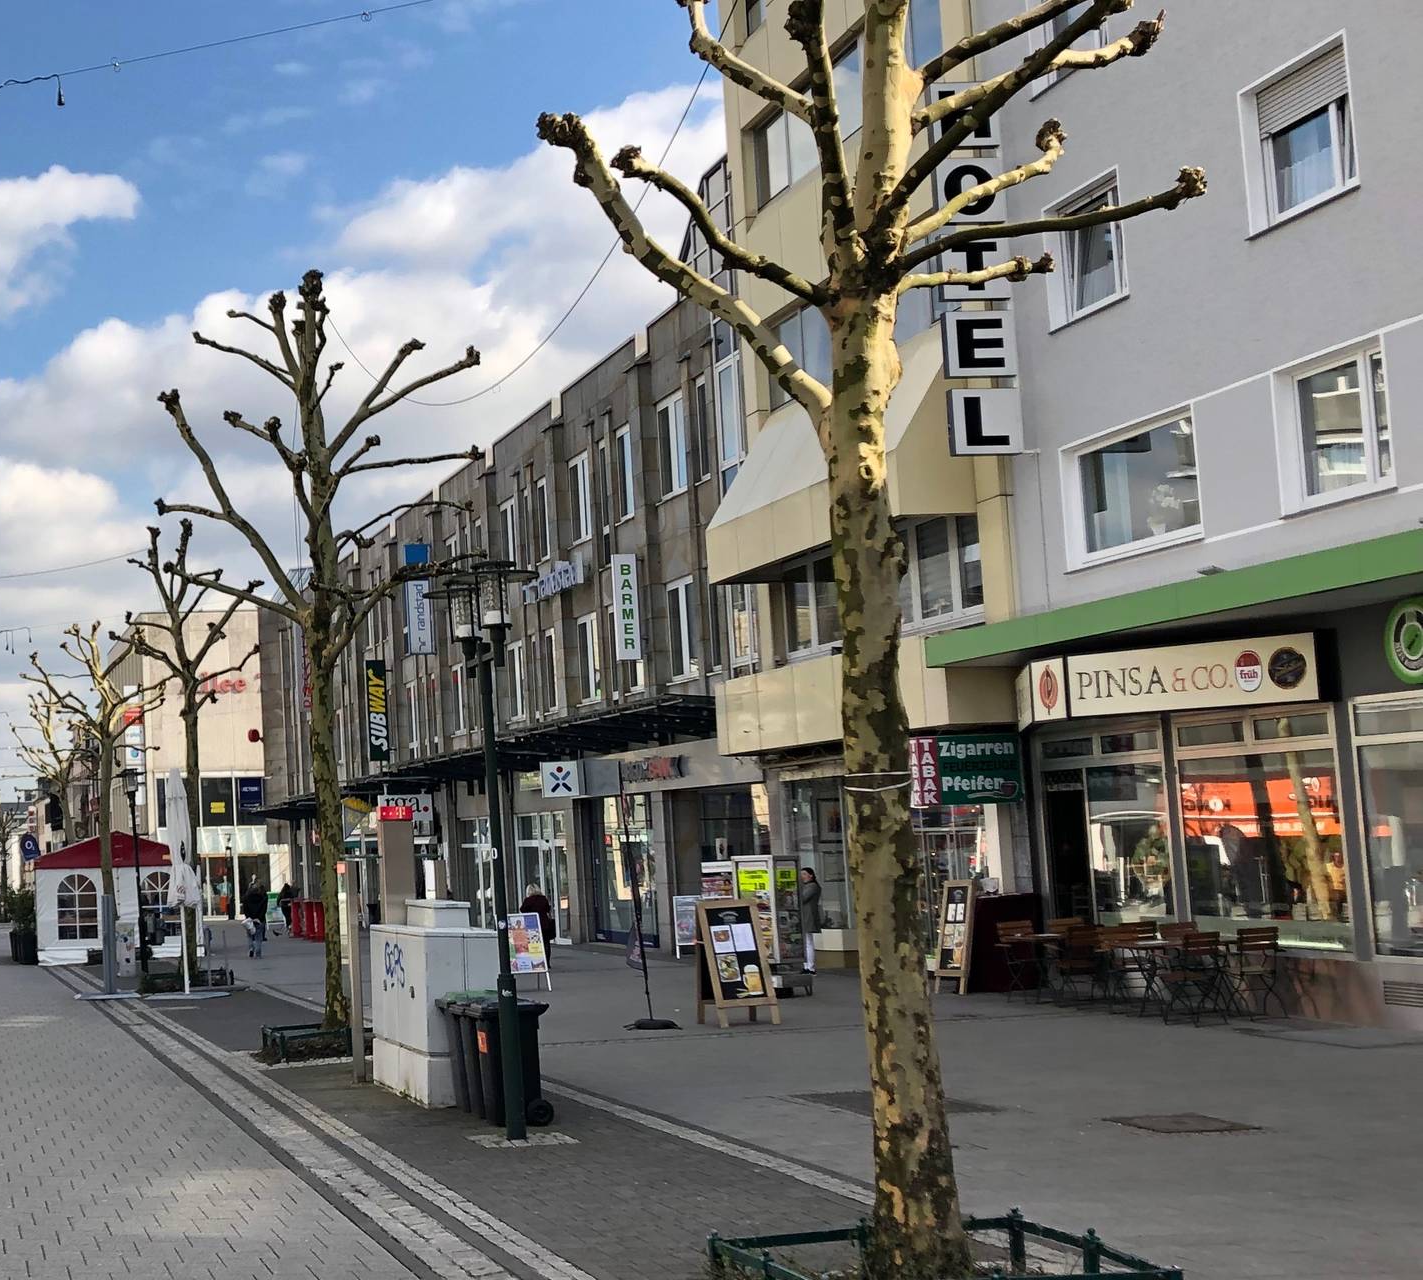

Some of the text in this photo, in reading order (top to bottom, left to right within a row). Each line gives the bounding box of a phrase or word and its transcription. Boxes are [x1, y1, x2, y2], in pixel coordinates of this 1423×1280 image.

[937, 90, 1010, 446] HOTEL
[413, 583, 426, 632] randstad
[619, 564, 635, 650] BARMER
[1076, 663, 1233, 700] PINSA & CO.
[1239, 669, 1258, 680] früh
[368, 668, 388, 752] SUBWAY
[909, 739, 922, 805] TABAK
[919, 739, 938, 804] TABAK
[938, 741, 1015, 759] Zigarren
[941, 776, 1005, 792] Pfeifen
